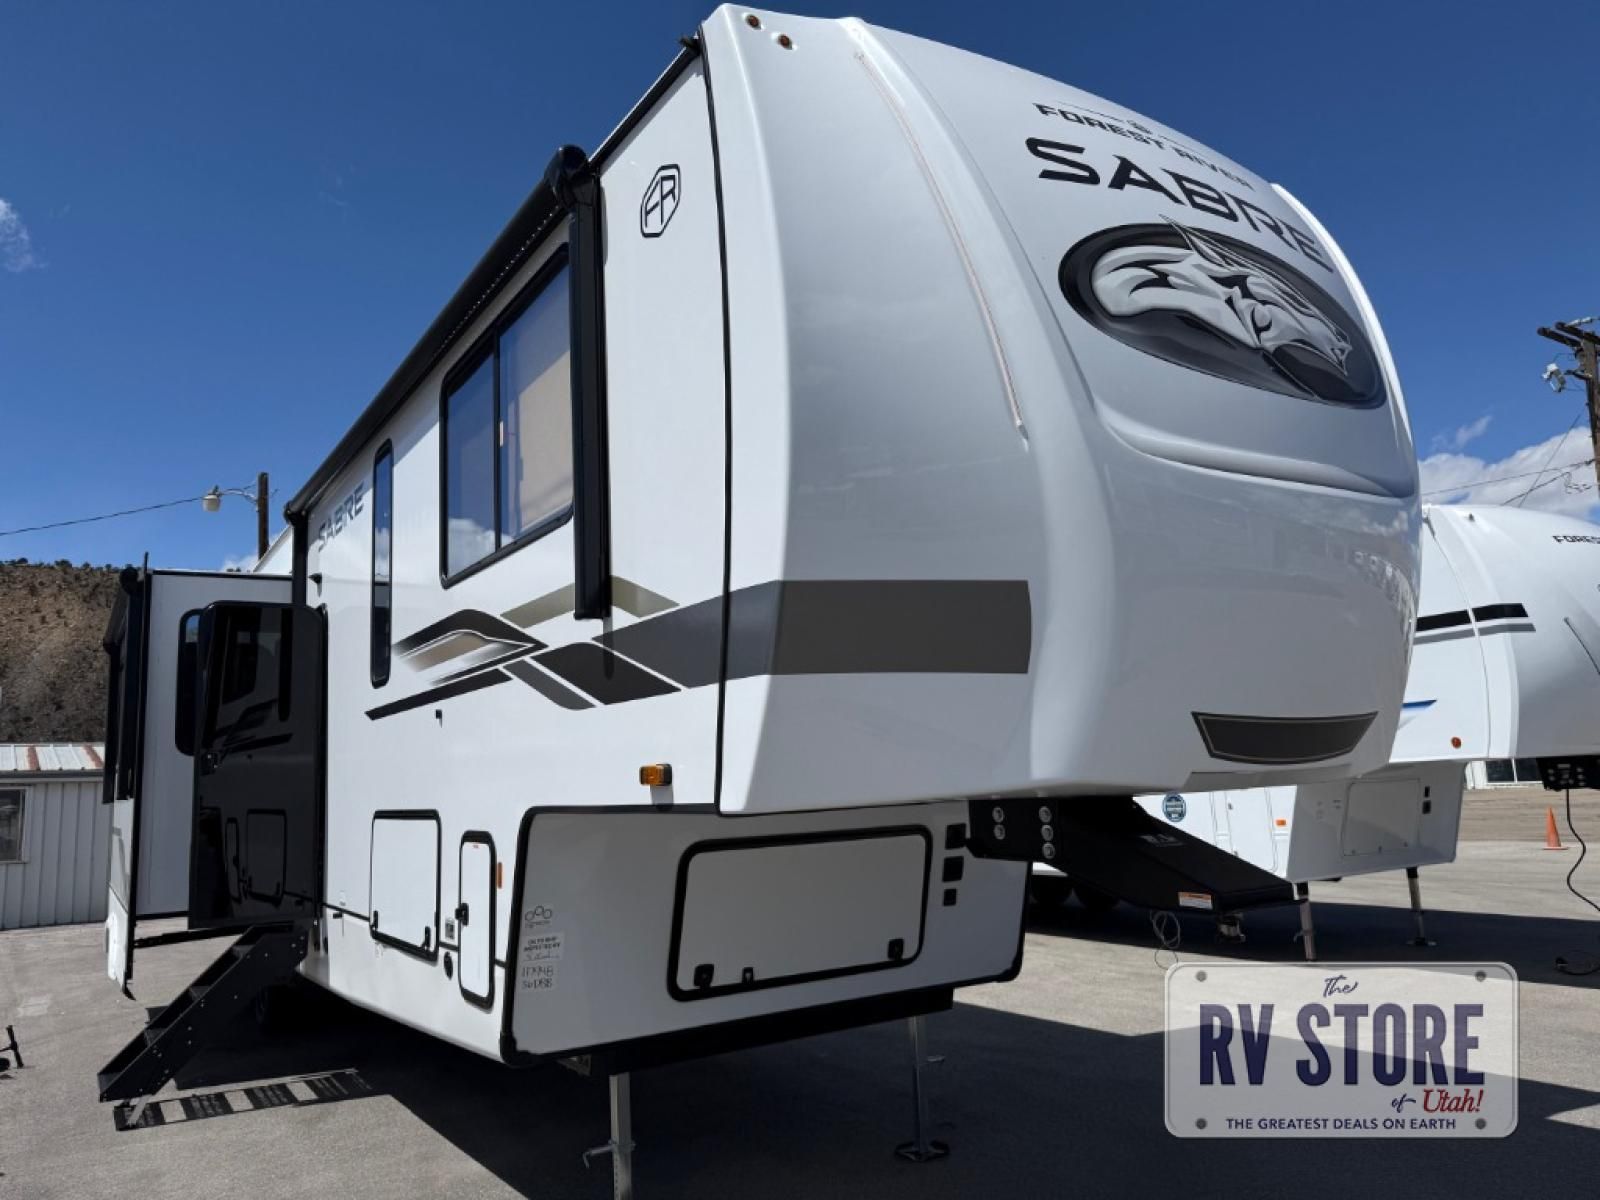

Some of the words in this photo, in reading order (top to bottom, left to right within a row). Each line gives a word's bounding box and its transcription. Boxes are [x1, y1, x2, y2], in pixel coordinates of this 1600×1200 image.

[1032, 102, 1165, 149] FOREST
[1171, 146, 1255, 192] RIVER
[1025, 136, 1334, 273] SABRE
[317, 481, 365, 553] SABRE
